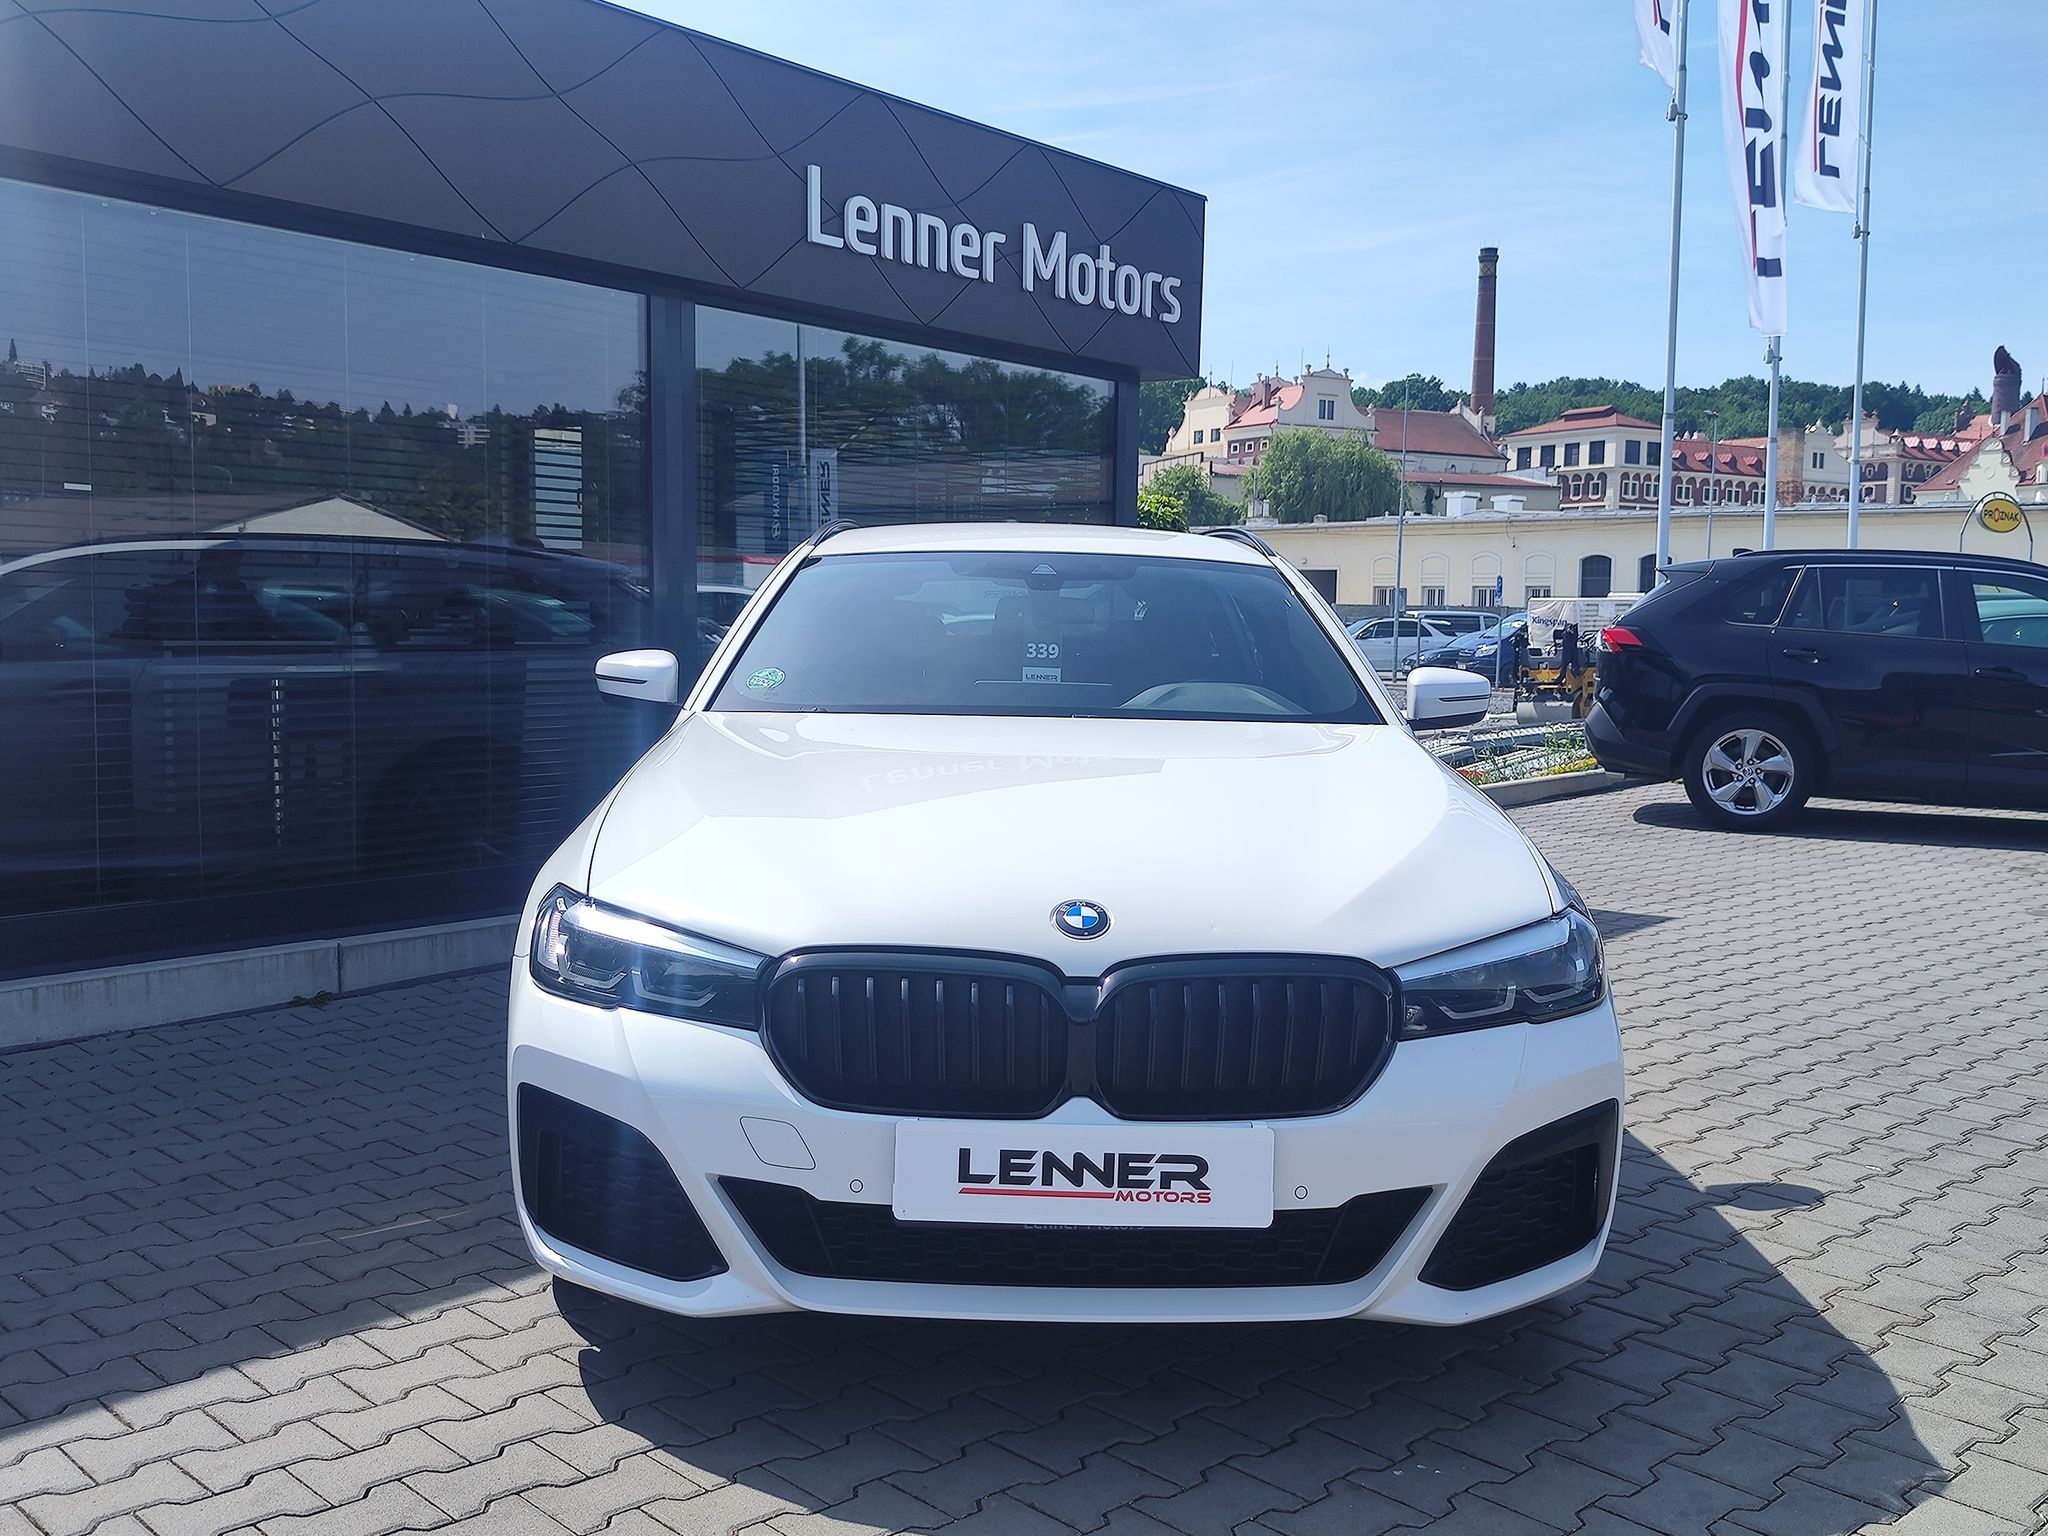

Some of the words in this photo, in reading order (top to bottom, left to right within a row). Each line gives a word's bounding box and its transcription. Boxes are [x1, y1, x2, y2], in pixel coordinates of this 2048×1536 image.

[806, 163, 1006, 284] Lenner
[1021, 222, 1182, 323] Motors
[1026, 642, 1059, 659] 339
[958, 1148, 1211, 1190] LENNER
[1115, 1190, 1211, 1203] MOTORS
